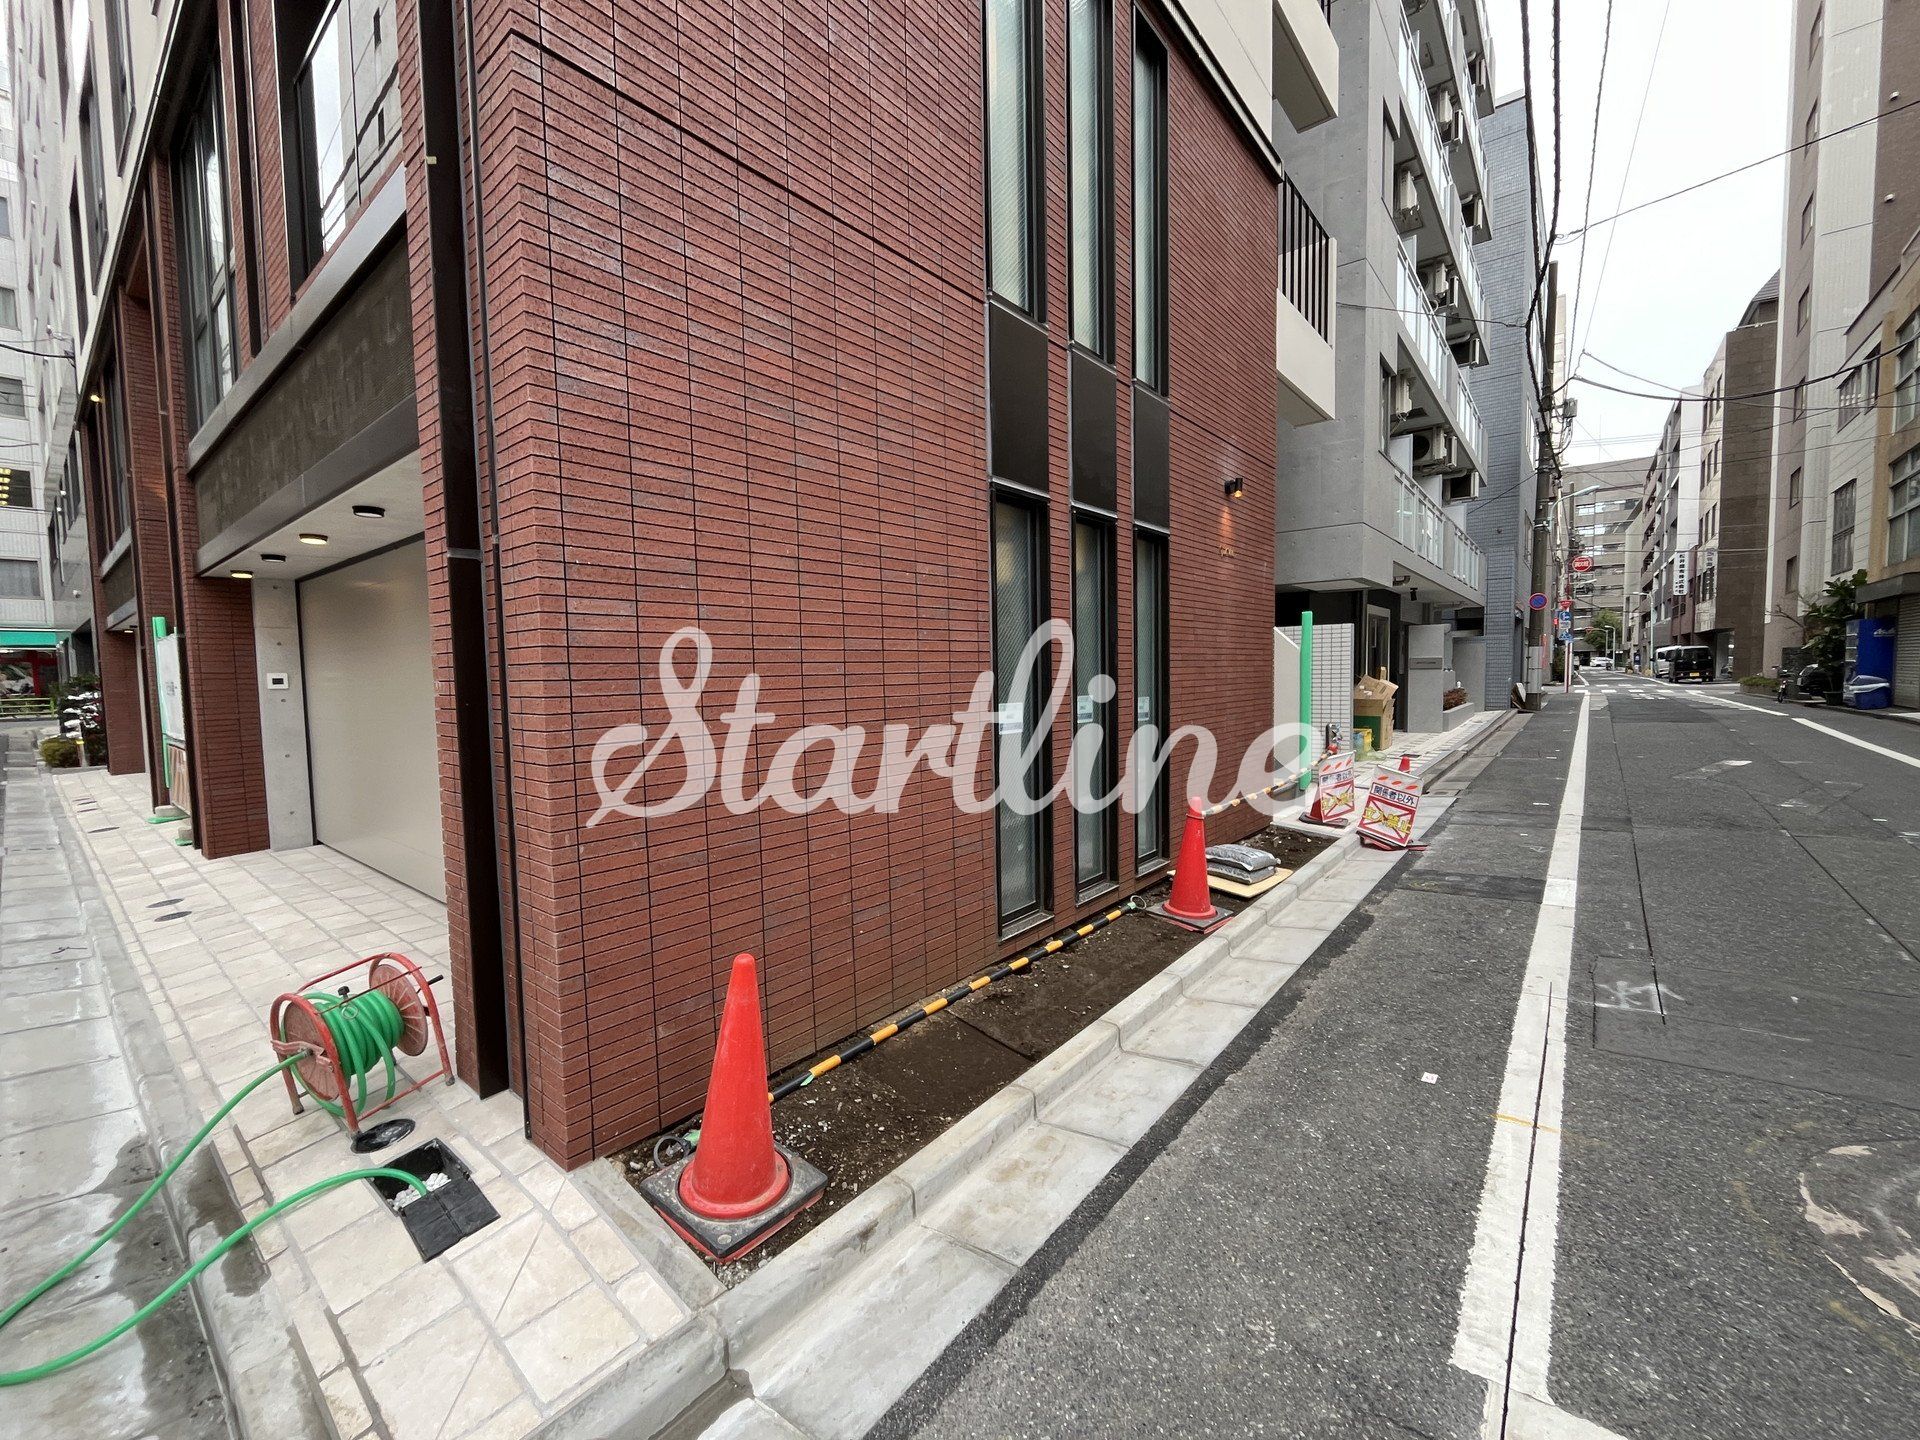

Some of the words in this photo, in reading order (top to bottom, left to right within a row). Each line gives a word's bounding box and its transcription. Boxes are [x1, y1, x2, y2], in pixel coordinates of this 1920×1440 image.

[1374, 785, 1415, 805] 関係者以外
[1363, 806, 1412, 834] 立入禁止
